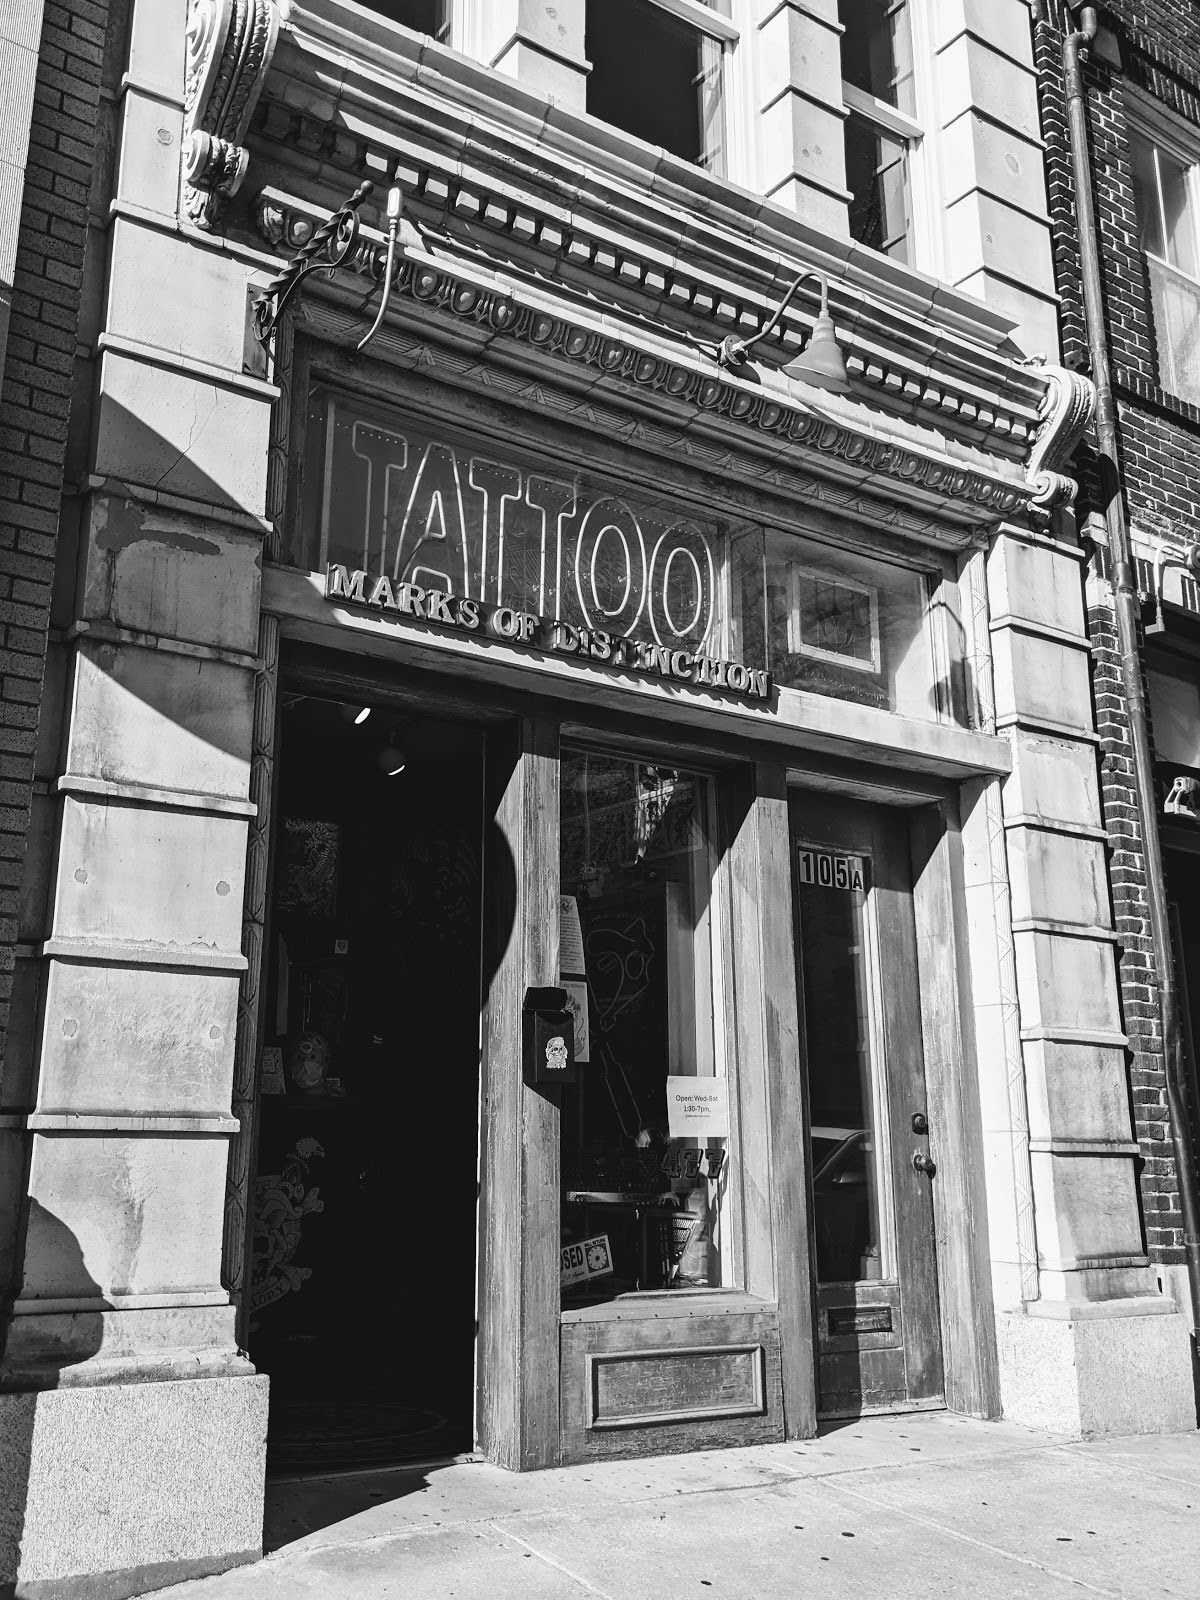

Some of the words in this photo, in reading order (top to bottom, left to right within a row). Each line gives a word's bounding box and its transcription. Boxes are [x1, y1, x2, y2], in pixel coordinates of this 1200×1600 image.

[351, 420, 715, 655] TATTOO
[330, 562, 481, 630] MARKS
[491, 605, 541, 643] OF
[551, 620, 770, 698] DISTINCTION
[802, 853, 863, 890] 105A
[675, 1094, 692, 1102] Open:
[560, 1245, 584, 1272] SED
